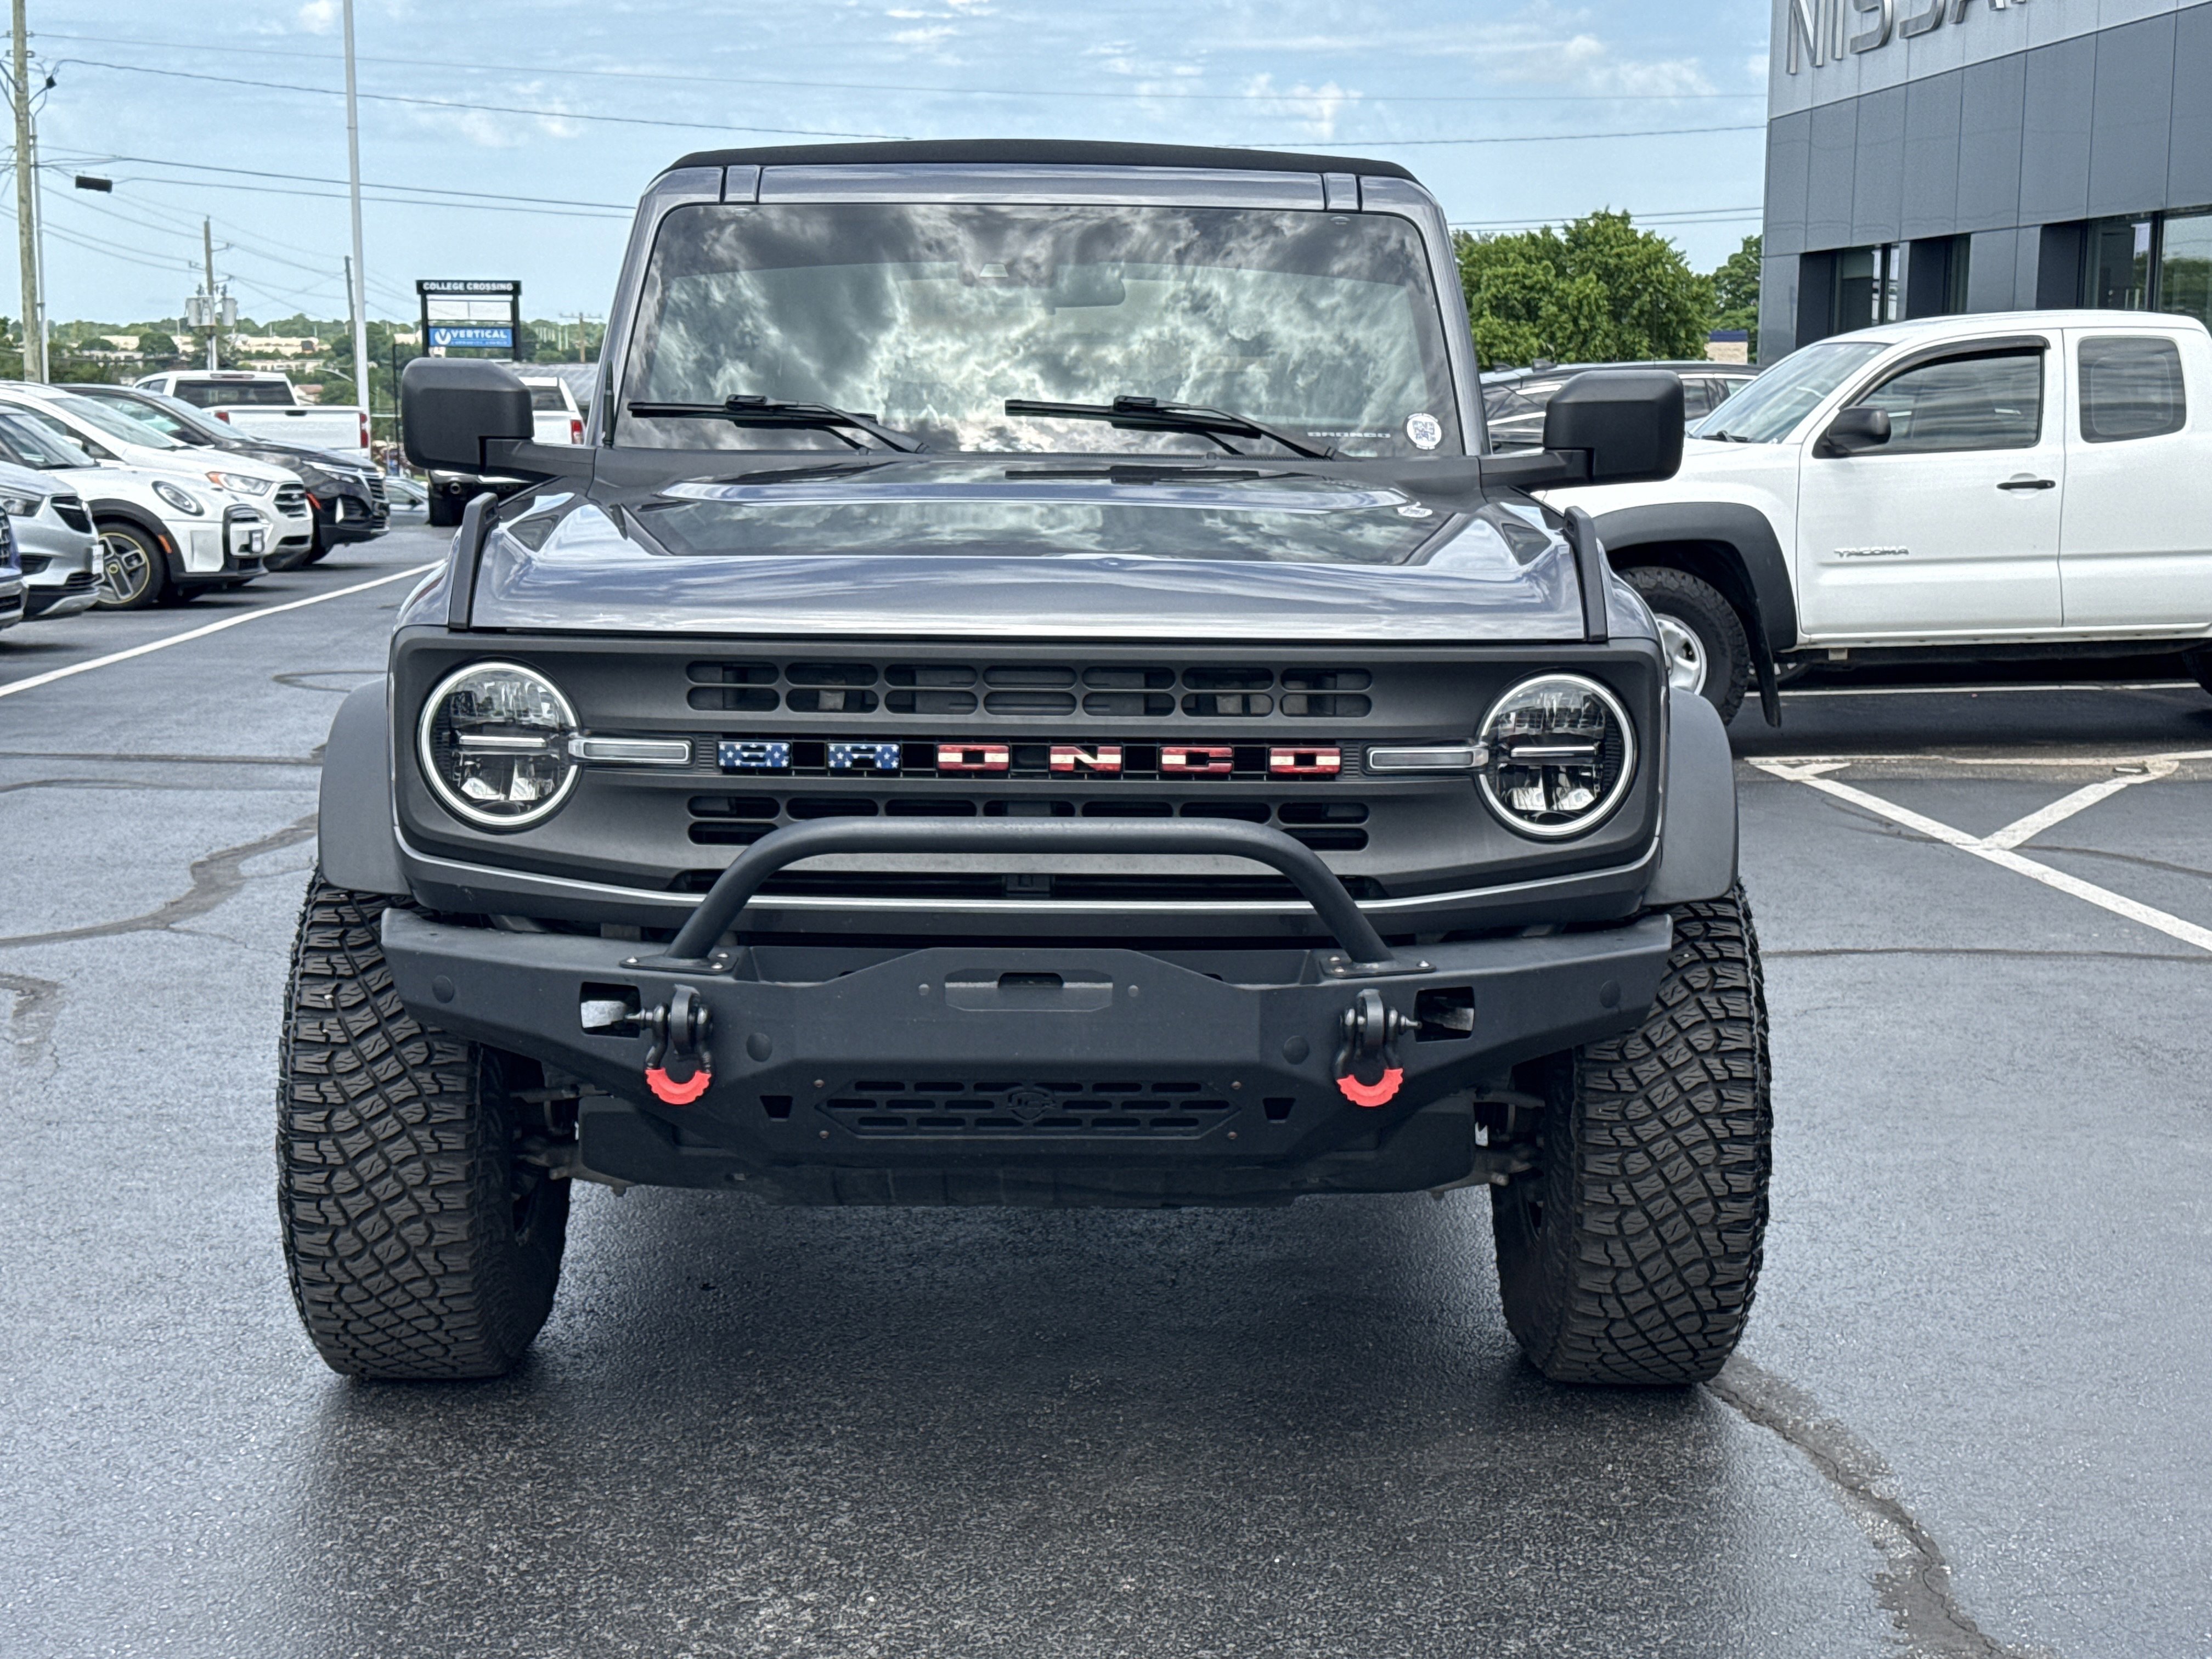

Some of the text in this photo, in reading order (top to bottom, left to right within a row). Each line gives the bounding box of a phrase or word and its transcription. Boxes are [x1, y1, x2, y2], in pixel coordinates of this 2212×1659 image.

[1786, 0, 2027, 75] NIS
[422, 281, 514, 291] COLLEGE CROSSING
[451, 330, 507, 338] VERTICAL
[1833, 546, 1909, 558] TACOMA
[717, 741, 1341, 774] BRONCO
